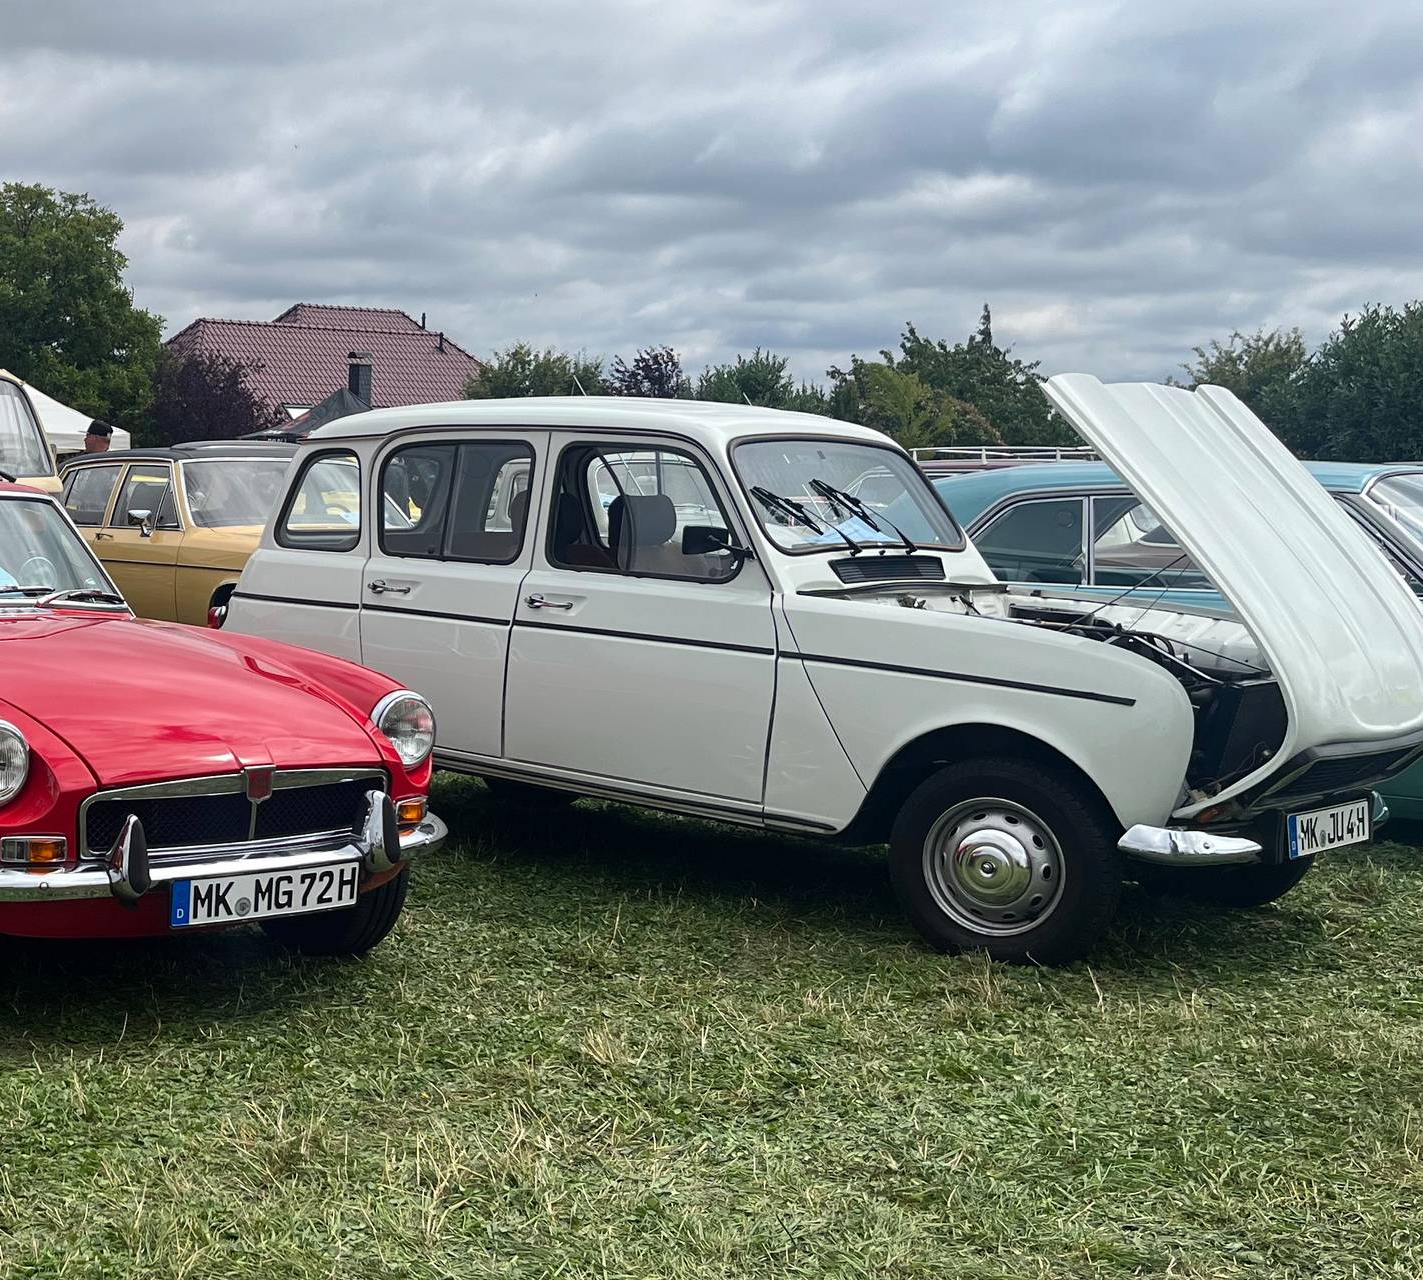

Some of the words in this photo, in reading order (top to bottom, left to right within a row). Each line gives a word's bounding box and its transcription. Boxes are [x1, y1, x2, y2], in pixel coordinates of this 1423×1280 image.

[1300, 816, 1319, 850] MK
[177, 908, 184, 919] D
[192, 881, 235, 919] MK
[253, 874, 294, 913] MG
[300, 866, 357, 907] 72H
